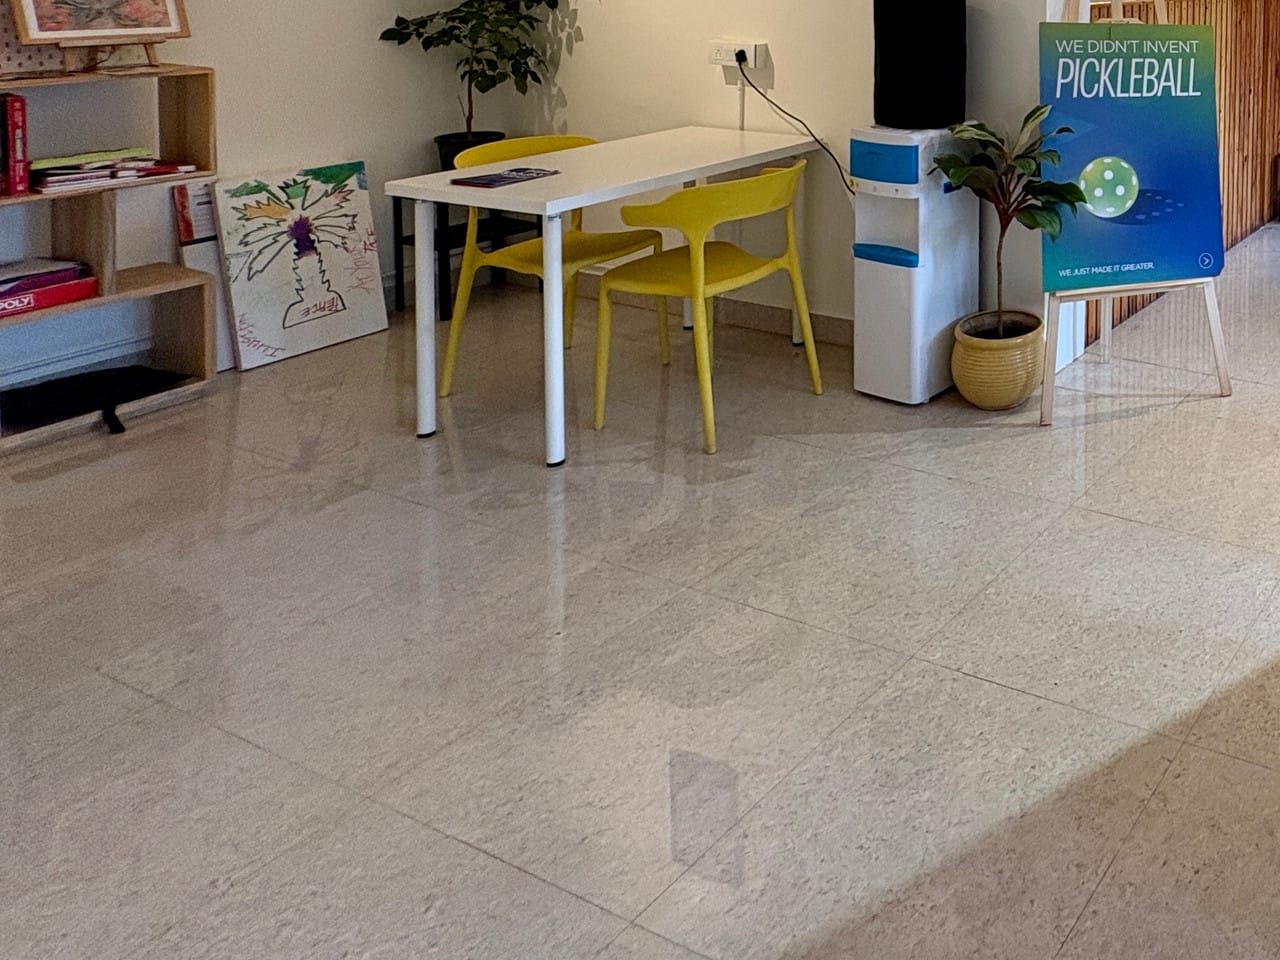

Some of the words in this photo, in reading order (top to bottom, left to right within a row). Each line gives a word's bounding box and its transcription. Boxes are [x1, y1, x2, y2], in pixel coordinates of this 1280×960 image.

[1055, 39, 1084, 53] WE
[1088, 39, 1140, 53] DIDN'T
[1143, 40, 1200, 53] INVENT
[1055, 57, 1202, 99] PICKLEBALL
[1058, 268, 1072, 278] WE
[1073, 267, 1091, 276] JUST
[1091, 265, 1113, 275] MADE
[1113, 264, 1120, 273] IT
